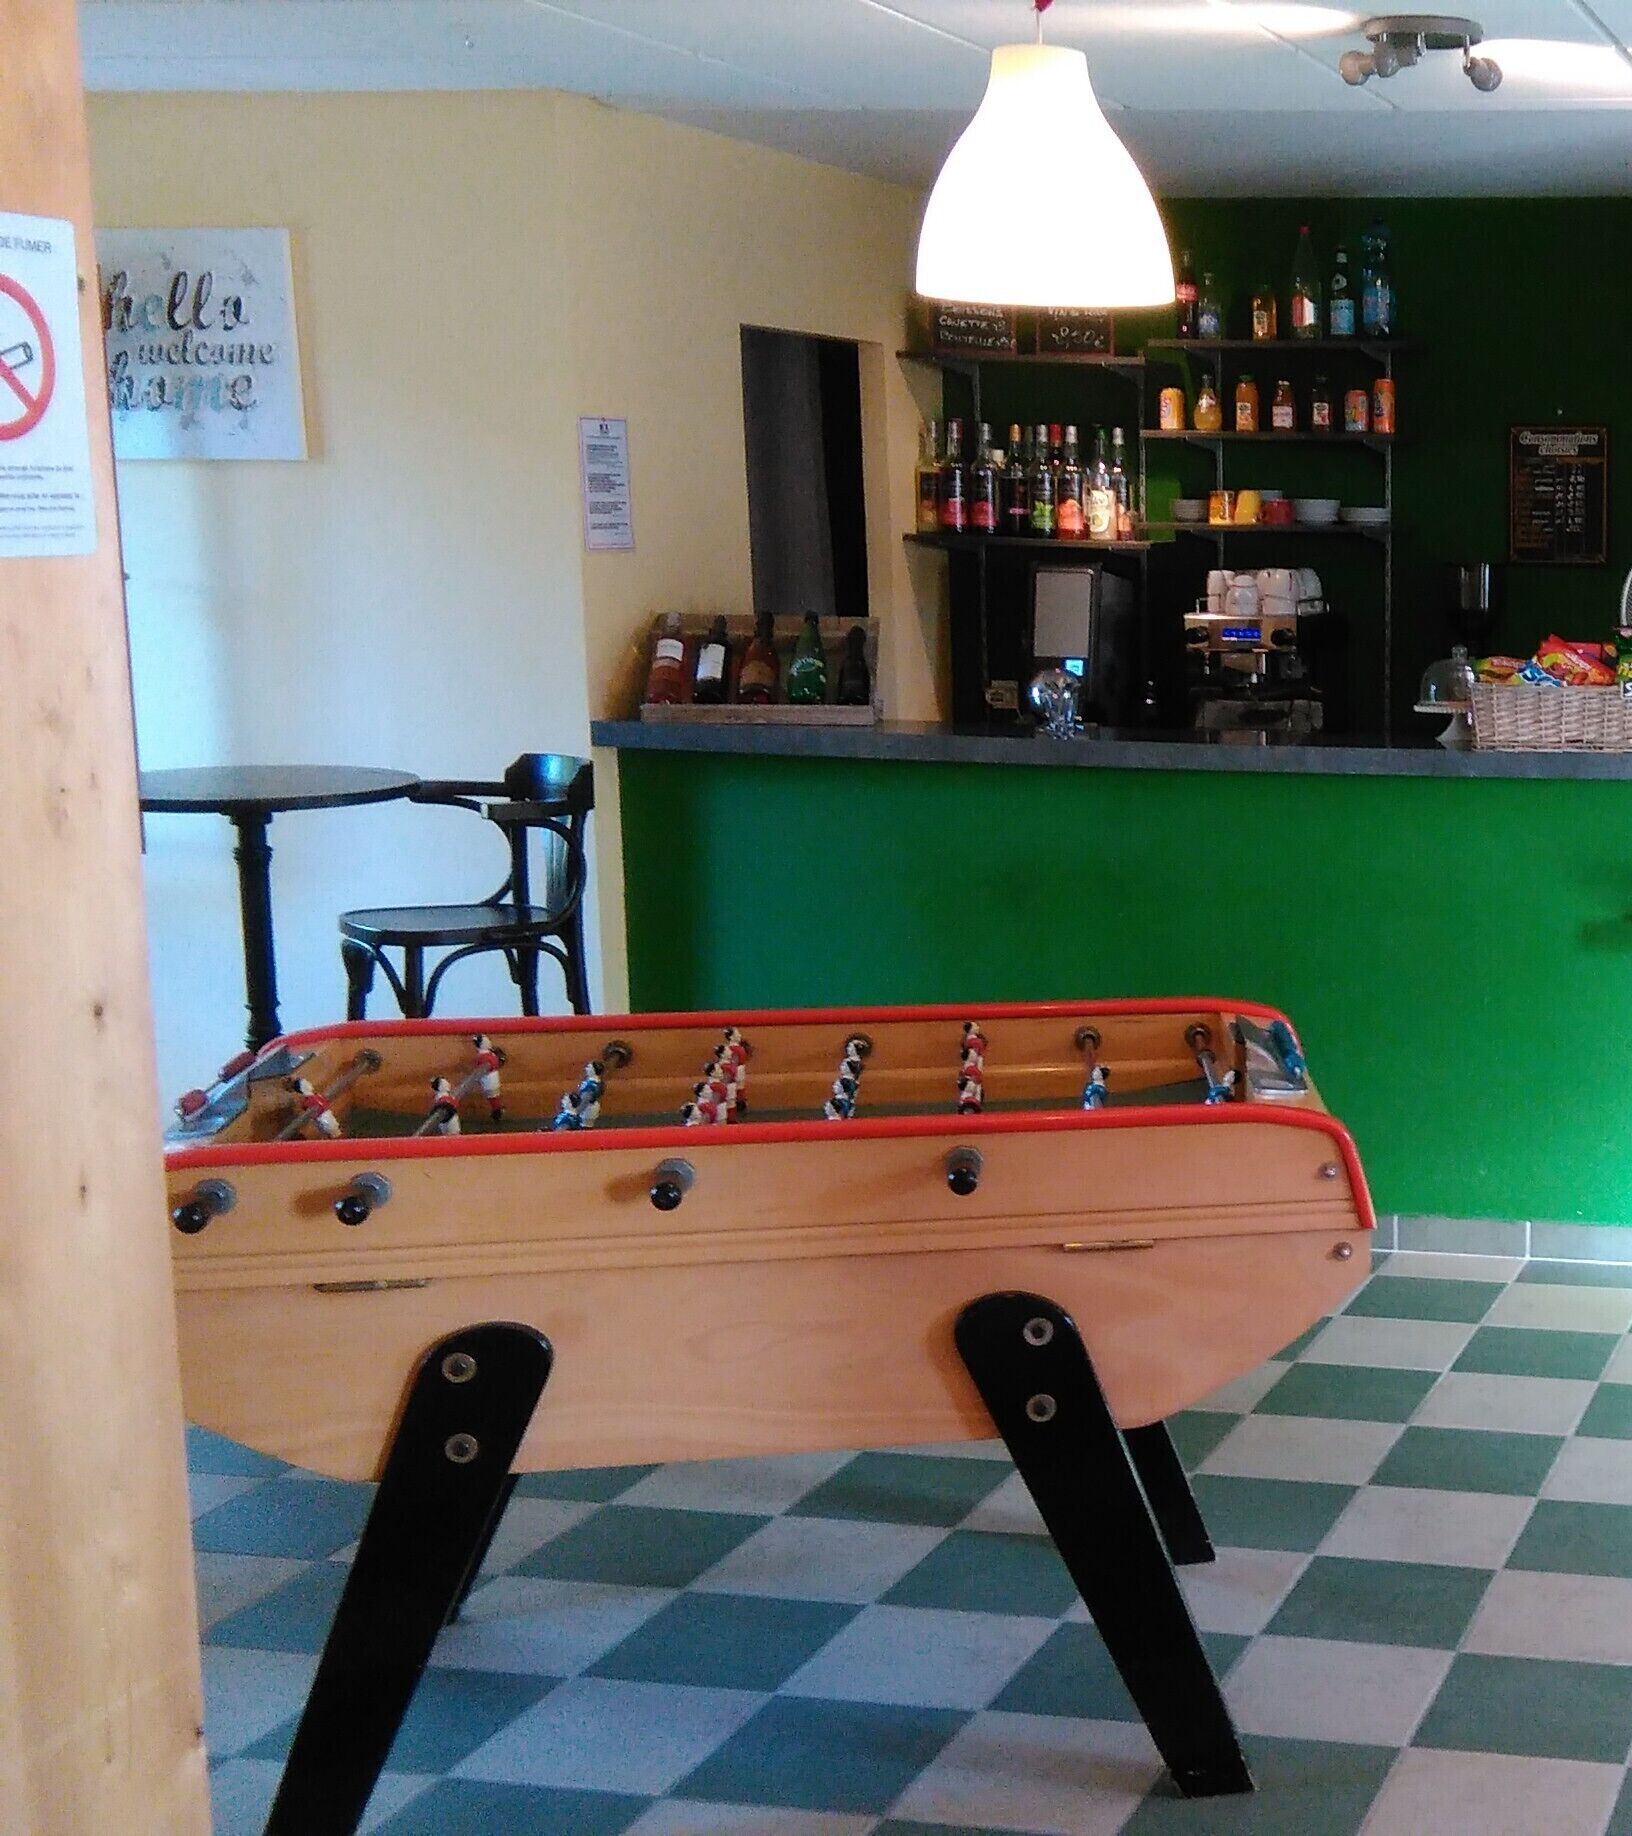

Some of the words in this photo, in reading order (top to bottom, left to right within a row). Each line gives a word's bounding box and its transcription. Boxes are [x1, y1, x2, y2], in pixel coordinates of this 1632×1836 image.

[14, 237, 52, 254] FUMER
[101, 270, 250, 333] hello
[138, 329, 274, 366] welcome
[110, 350, 258, 412] home
